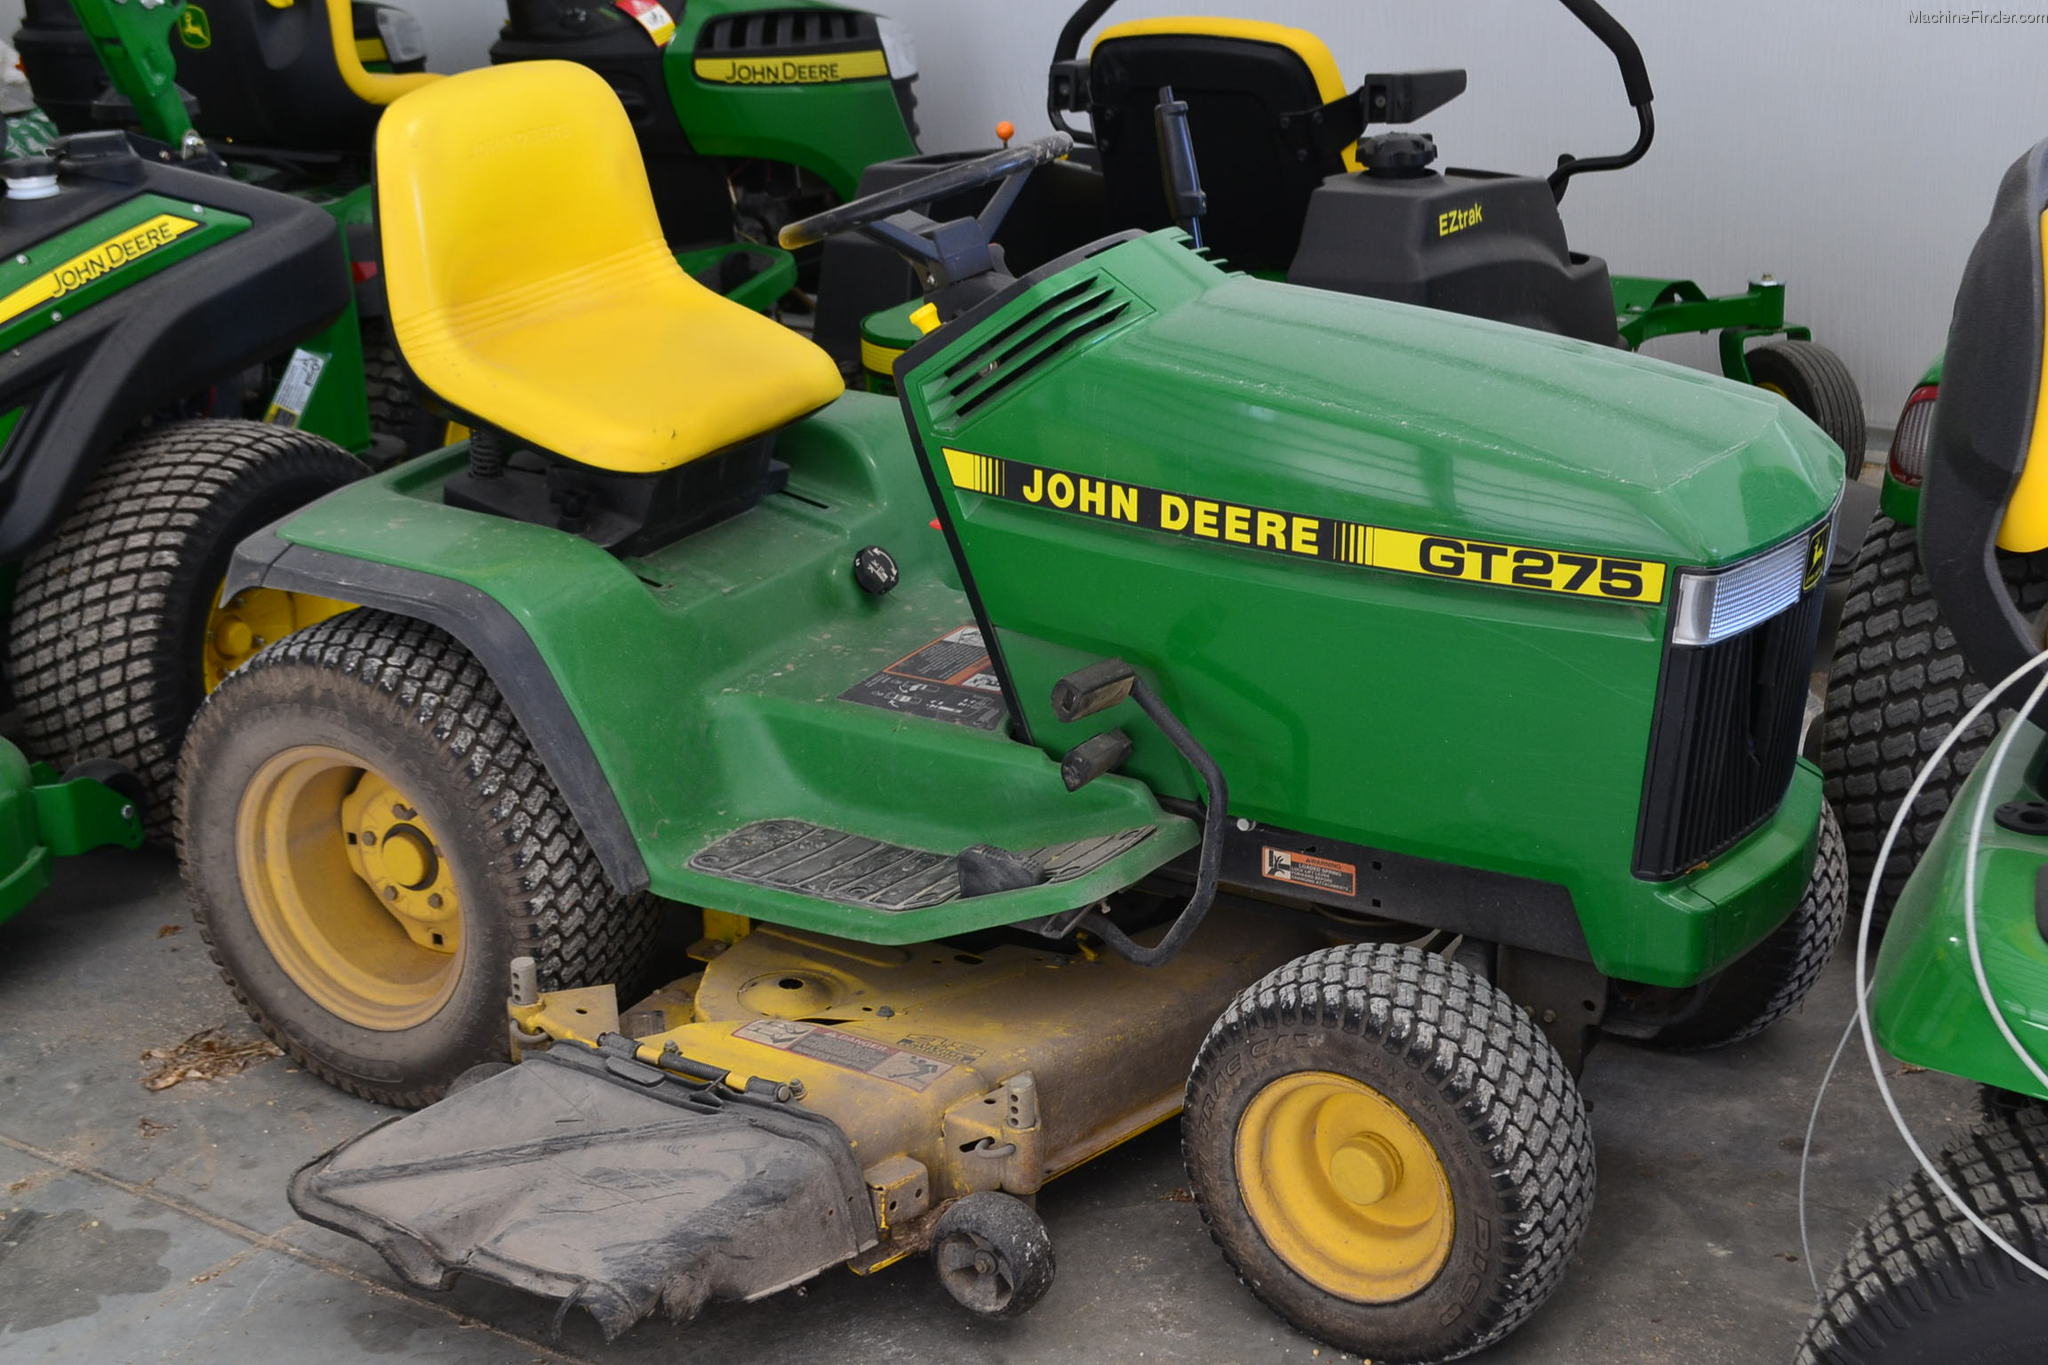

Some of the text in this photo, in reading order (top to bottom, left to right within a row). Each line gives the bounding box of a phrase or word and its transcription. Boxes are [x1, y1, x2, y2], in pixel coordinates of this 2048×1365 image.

[725, 62, 839, 81] JOHN DEERE
[1439, 203, 1483, 237] EZtrak
[52, 222, 172, 295] JOHN DEERE
[1022, 469, 1319, 555] JOHN DEERE
[1419, 537, 1643, 598] GT275
[836, 1034, 889, 1052] DANGER
